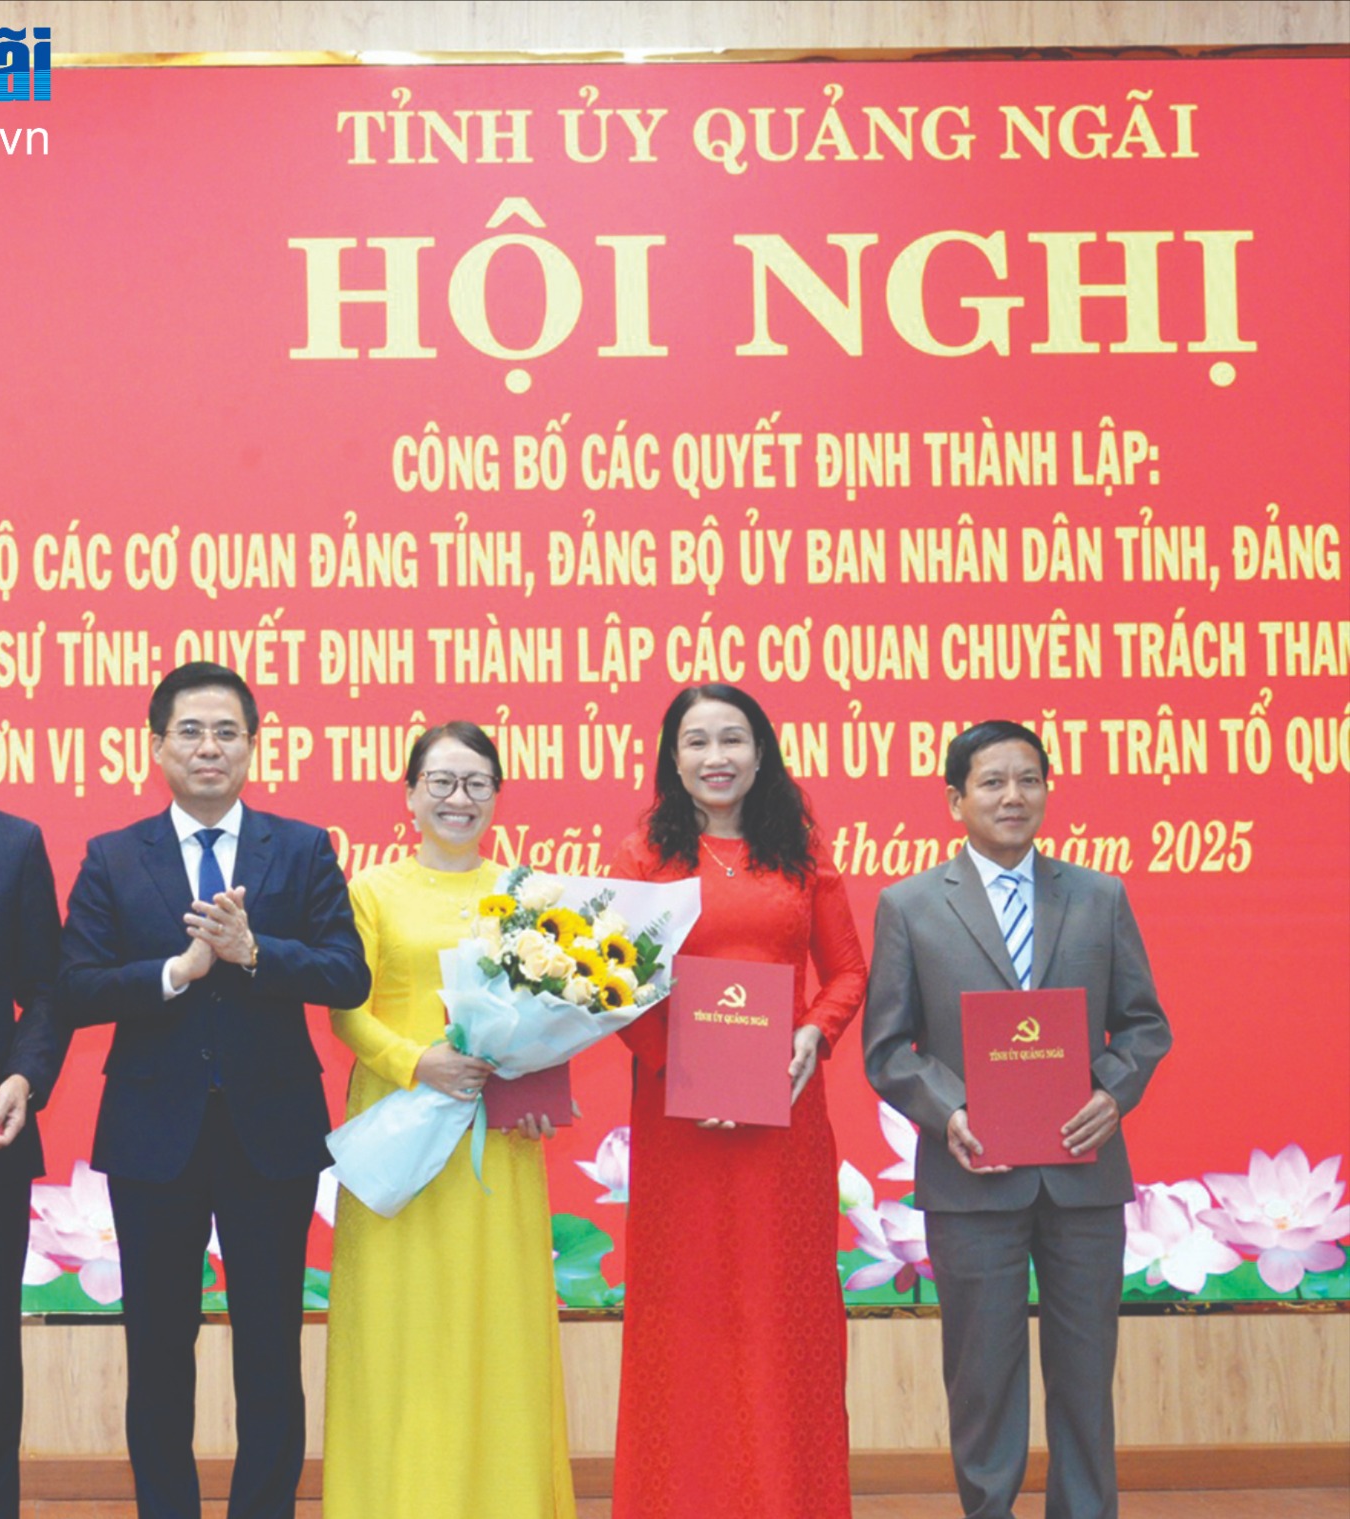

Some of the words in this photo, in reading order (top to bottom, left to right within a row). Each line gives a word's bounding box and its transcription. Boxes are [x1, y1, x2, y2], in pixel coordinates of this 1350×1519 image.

[337, 87, 534, 164] TỈNH
[558, 85, 668, 163] ỦY
[693, 84, 975, 175] QUẢNG
[999, 90, 1198, 159] NGÃI
[288, 197, 668, 394] HỘI
[733, 230, 1257, 386] NGHỊ
[392, 421, 499, 492] CÔNG
[514, 413, 571, 490] BỐ
[581, 420, 660, 490] CÁC
[673, 411, 802, 499] QUYẾT
[816, 433, 910, 501] ĐỊNH
[924, 417, 1057, 486] THÀNH
[1073, 416, 1159, 496] LẬP:
[33, 519, 112, 591] CÁC
[125, 525, 180, 590] CƠ
[190, 533, 296, 599] QUAN
[309, 511, 418, 588] ĐẢNG
[430, 512, 534, 597] TỈNH,
[548, 509, 656, 586] ĐẢNG
[671, 515, 724, 595] BỘ
[740, 508, 792, 585] ỦY
[807, 529, 885, 583] BAN
[900, 513, 1007, 582] NHÂN
[1023, 513, 1102, 581] DÂN
[1115, 507, 1219, 591] TỈNH,
[1233, 503, 1340, 580] ĐẢNG
[319, 629, 414, 698] ĐỊNH
[428, 613, 562, 683] THÀNH
[578, 612, 654, 693] LẬP
[667, 611, 745, 682] CÁC
[758, 617, 812, 682] CƠ
[823, 624, 929, 691] QUAN
[942, 609, 1101, 680] CHUYÊN
[1114, 608, 1245, 678] TRÁCH
[48, 728, 84, 797] VỊ
[579, 702, 643, 789] ỦY;
[843, 700, 895, 778] ỦY
[1018, 708, 1087, 791] ẶT
[1101, 704, 1207, 785] TRẬN
[1220, 688, 1272, 774] TỔ
[1149, 821, 1253, 872] 2025
